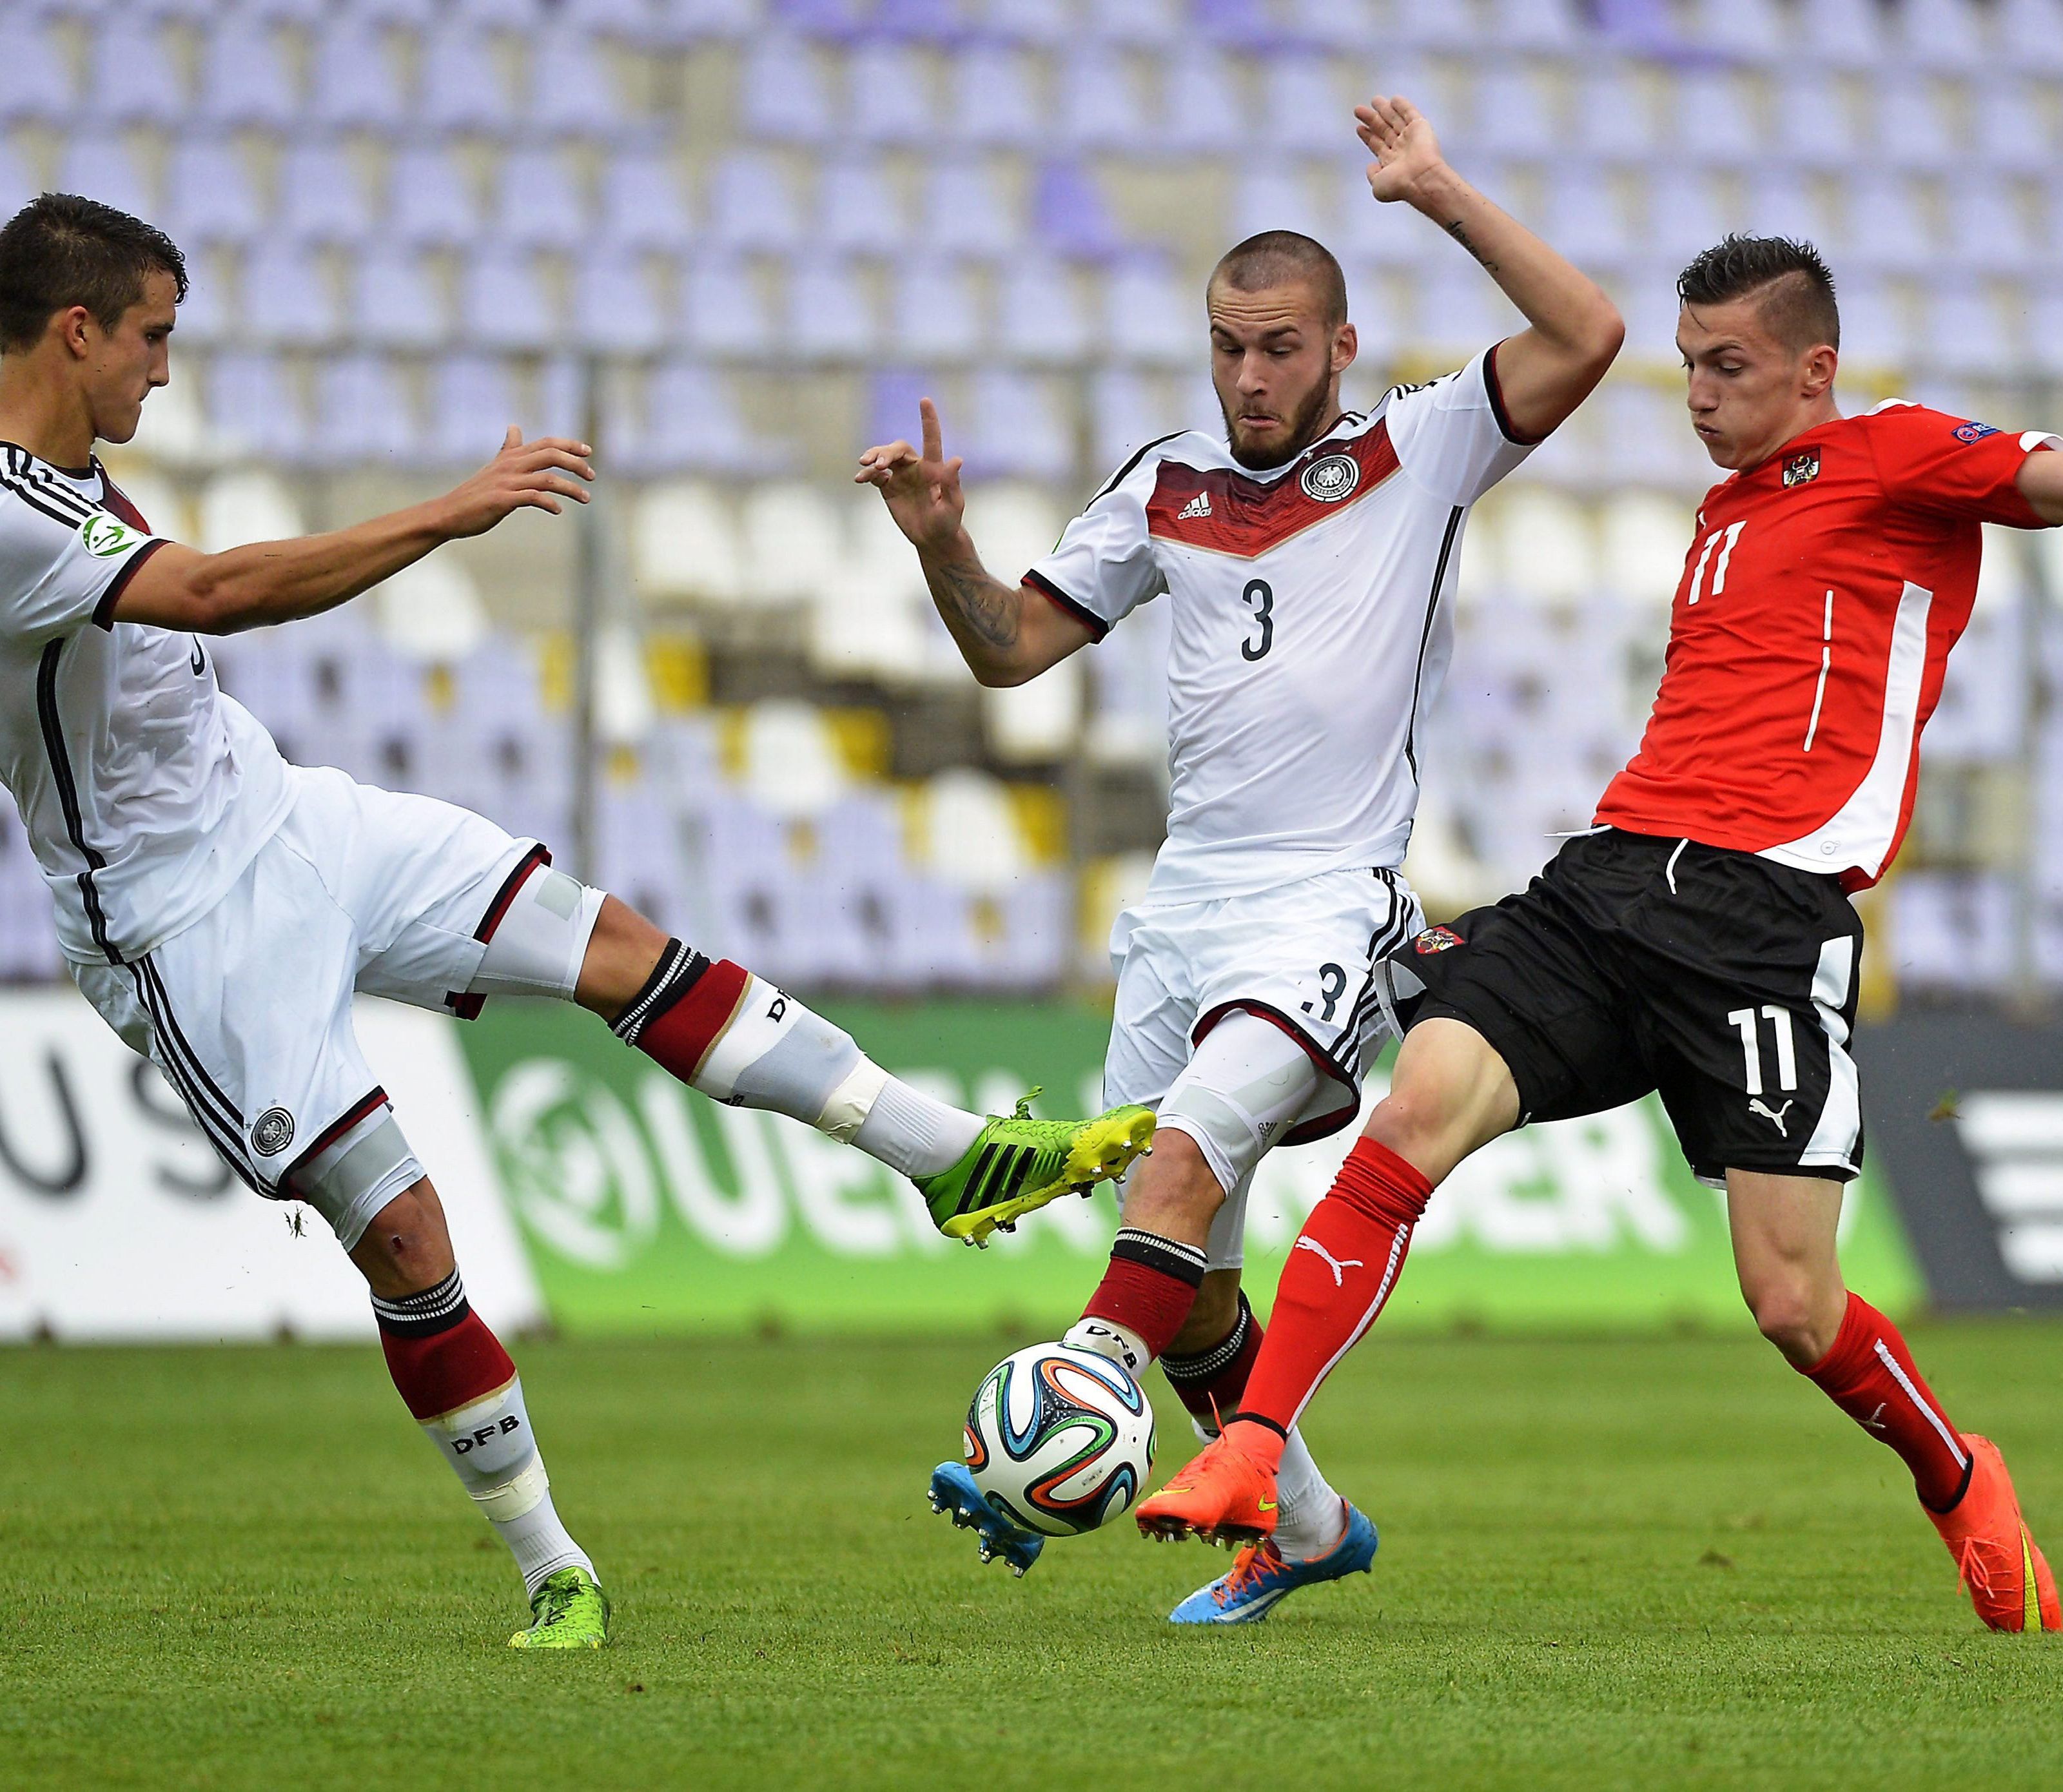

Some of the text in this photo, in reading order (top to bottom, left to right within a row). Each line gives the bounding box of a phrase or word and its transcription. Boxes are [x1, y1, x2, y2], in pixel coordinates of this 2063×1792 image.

[1177, 507, 1213, 520] adidas
[1688, 520, 1747, 605] 11
[1242, 579, 1273, 661] 3
[1728, 1005, 1797, 1095] 11
[451, 1415, 520, 1455] DFB
